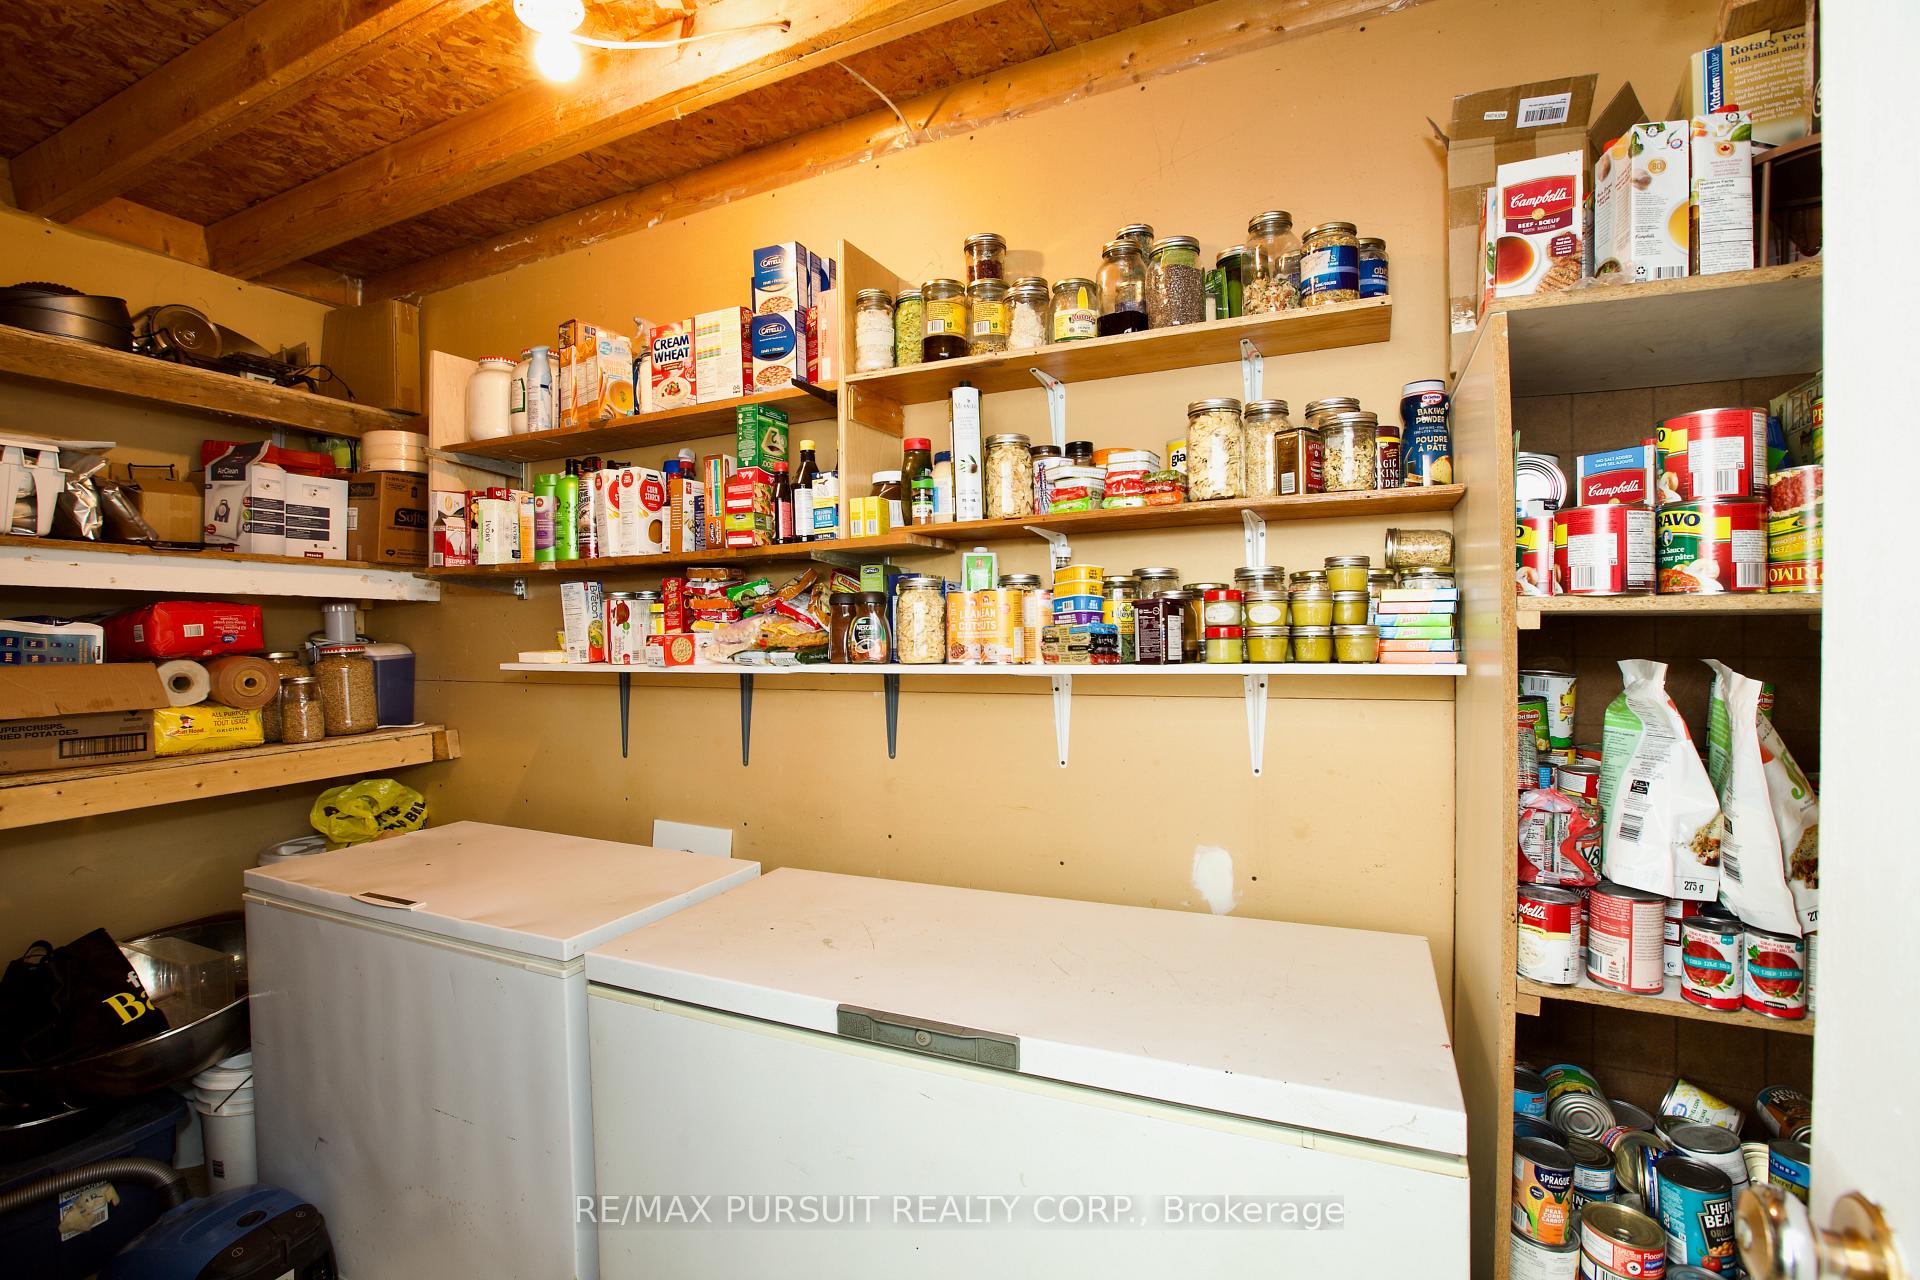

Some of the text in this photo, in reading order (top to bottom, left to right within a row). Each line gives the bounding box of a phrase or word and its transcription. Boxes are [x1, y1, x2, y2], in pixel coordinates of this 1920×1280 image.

[1730, 39, 1777, 57] Rotary
[1730, 56, 1750, 66] with
[1753, 47, 1779, 59] stand
[1782, 43, 1799, 52] and
[1510, 188, 1571, 208] Campbell's
[654, 334, 689, 351] CREAM
[654, 346, 689, 364] WHEAT
[1417, 408, 1445, 416] BAKING
[1416, 416, 1445, 424] POWDER
[1416, 436, 1448, 444] POUDRE
[1427, 442, 1447, 451] PÂTE
[646, 486, 658, 494] CORN
[1588, 480, 1640, 497] Campbell's
[1675, 554, 1695, 562] pâtes
[24, 729, 79, 738] POTATOES
[1684, 881, 1704, 893] 275 g
[1540, 1173, 1570, 1186] SPRAGUE
